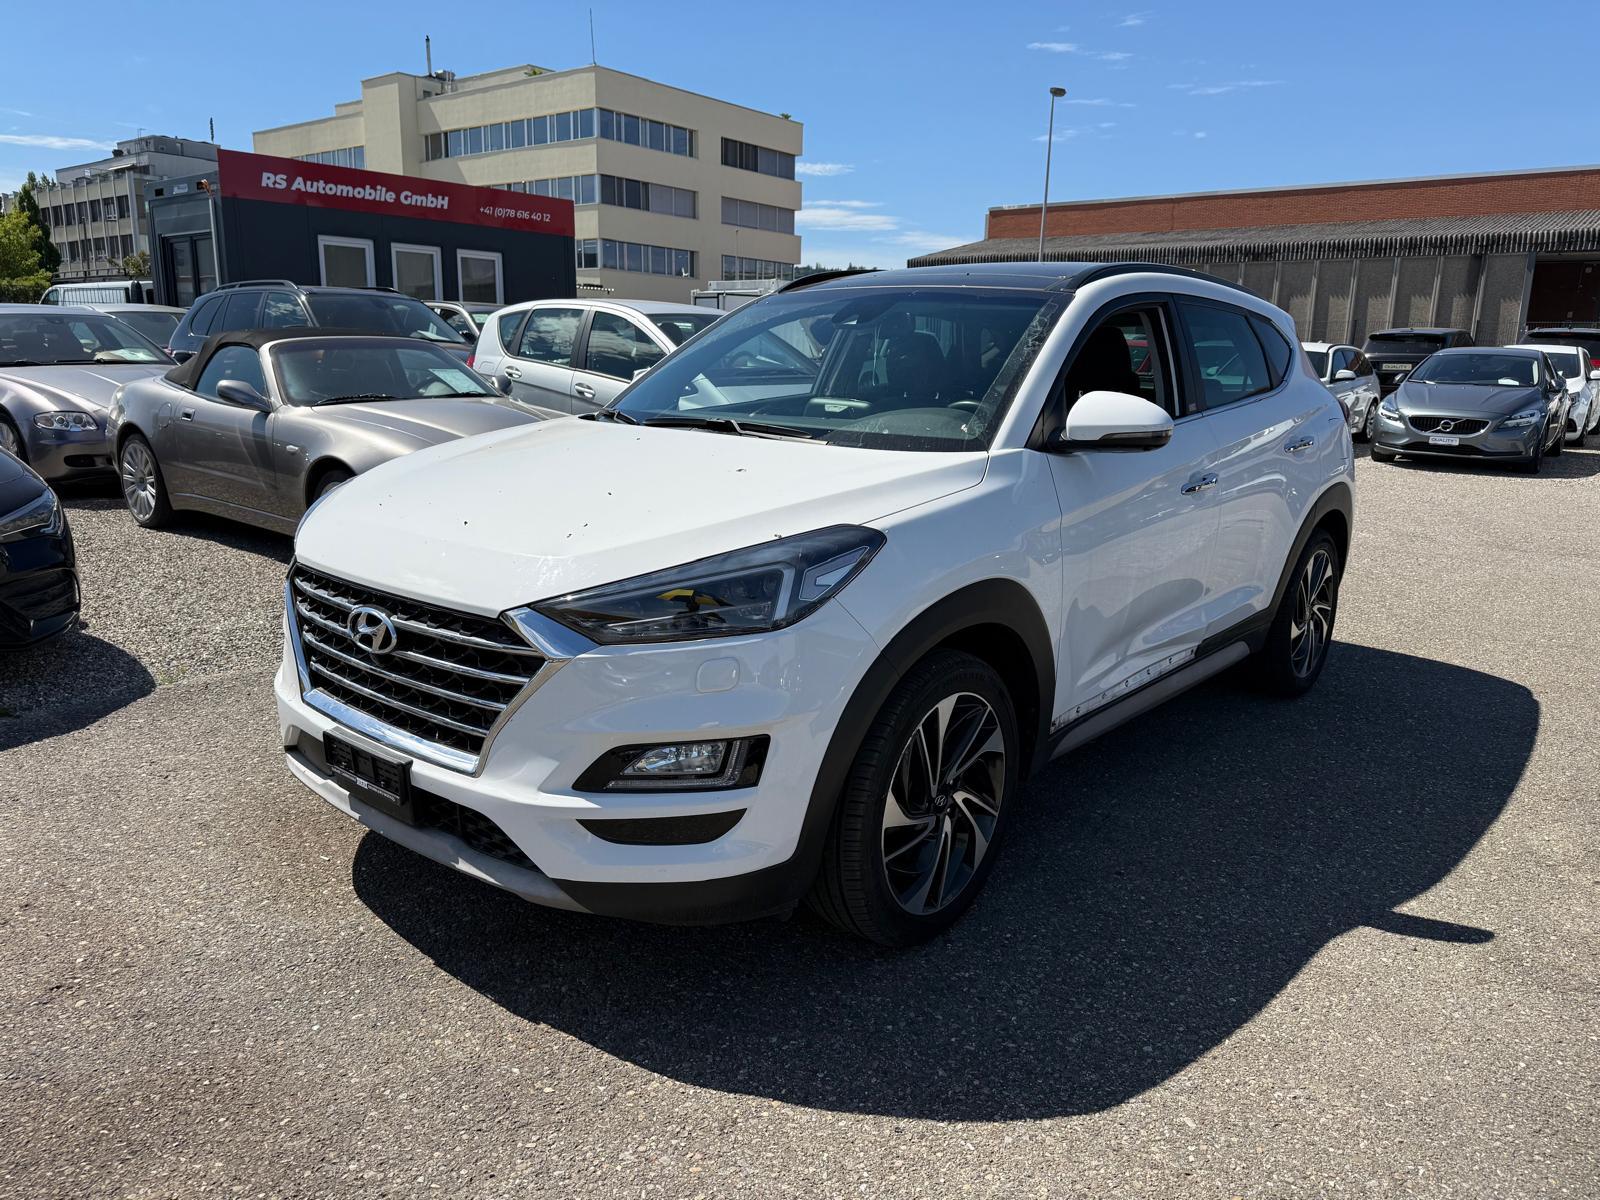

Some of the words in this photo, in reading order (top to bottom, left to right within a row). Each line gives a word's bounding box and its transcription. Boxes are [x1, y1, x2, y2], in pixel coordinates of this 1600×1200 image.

[261, 172, 287, 190] RS
[291, 176, 396, 203] Automobile
[400, 191, 449, 210] GmbH
[479, 206, 493, 215] +41
[494, 207, 516, 218] (0)78
[516, 210, 530, 220] 616
[530, 212, 542, 221] 40
[543, 213, 551, 222] 12
